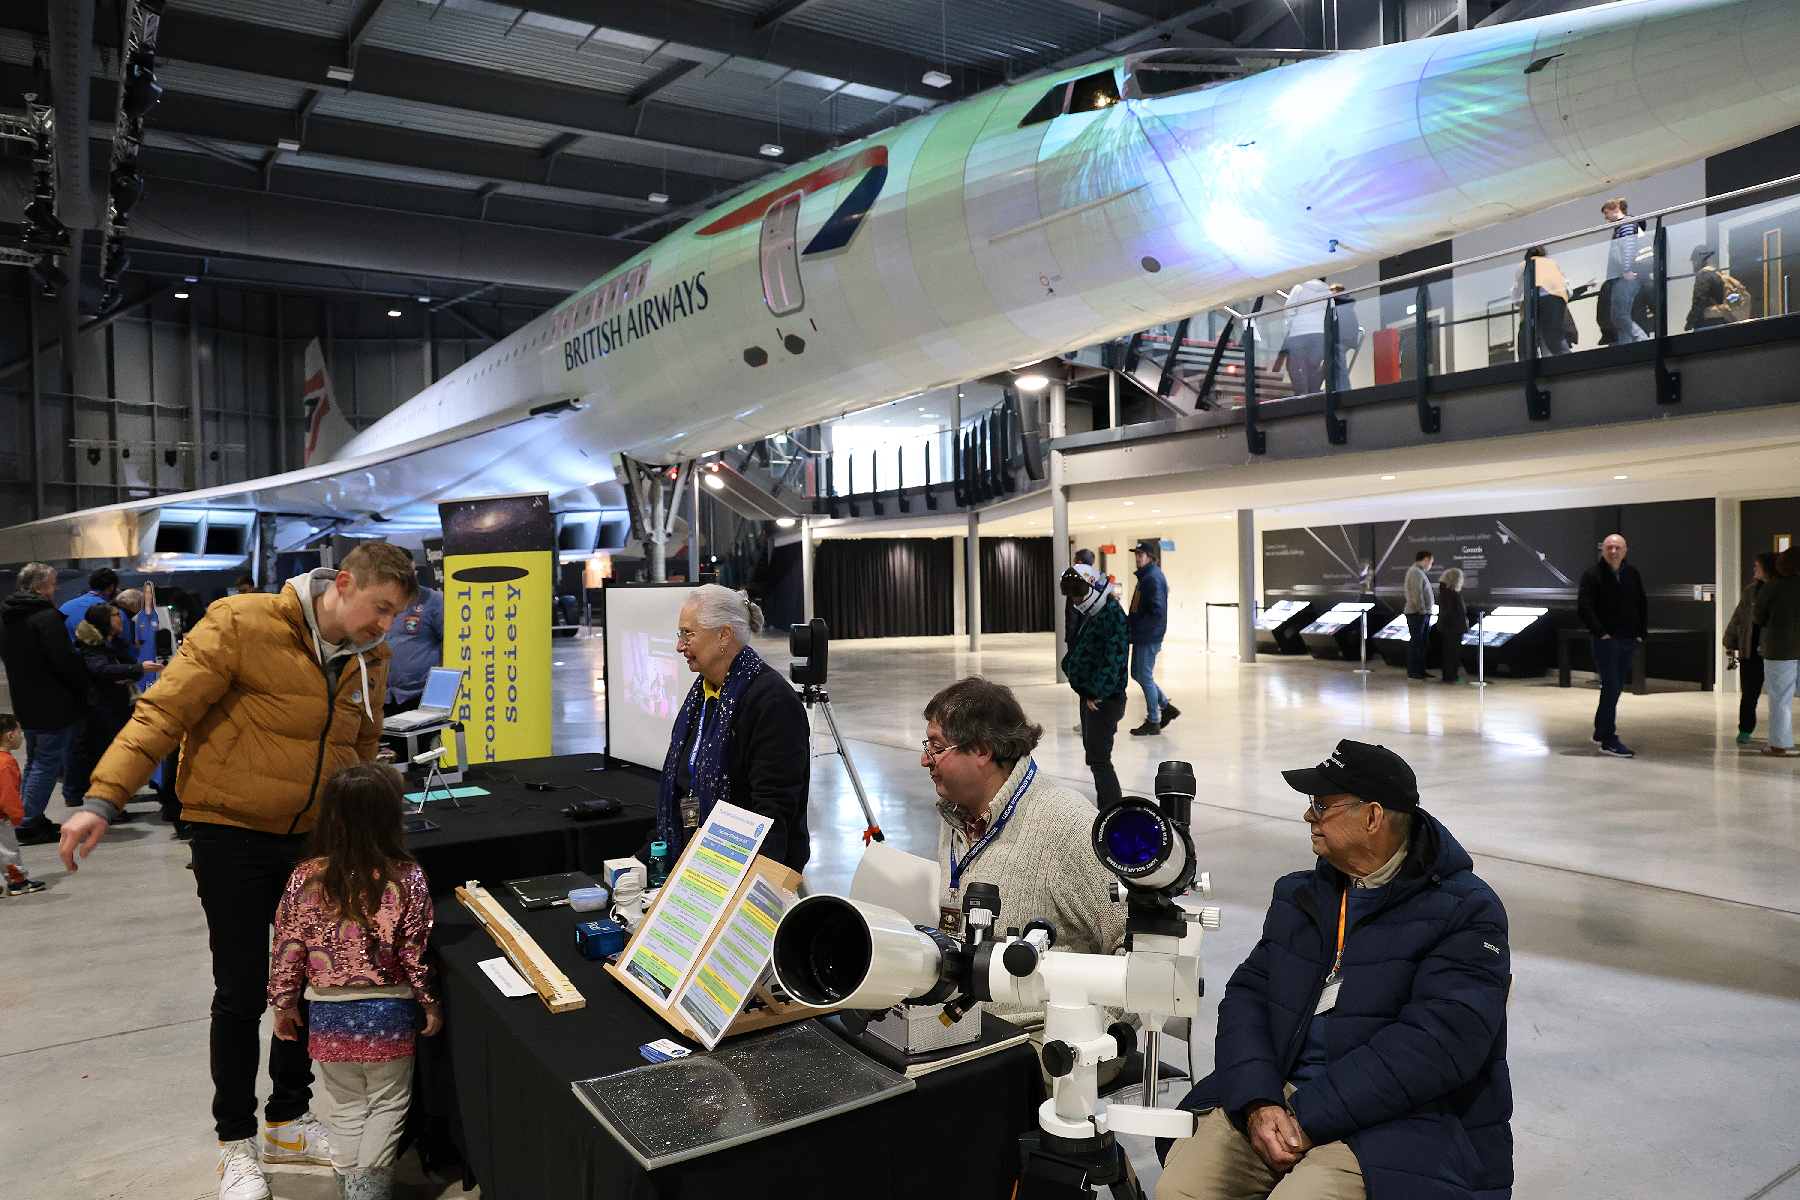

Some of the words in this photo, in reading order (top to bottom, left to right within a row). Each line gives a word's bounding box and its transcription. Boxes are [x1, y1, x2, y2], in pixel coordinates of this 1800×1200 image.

[564, 314, 623, 372] BRITISH
[627, 271, 708, 343] AIRWAYS
[458, 585, 471, 722] Bristol
[504, 583, 520, 722] Society
